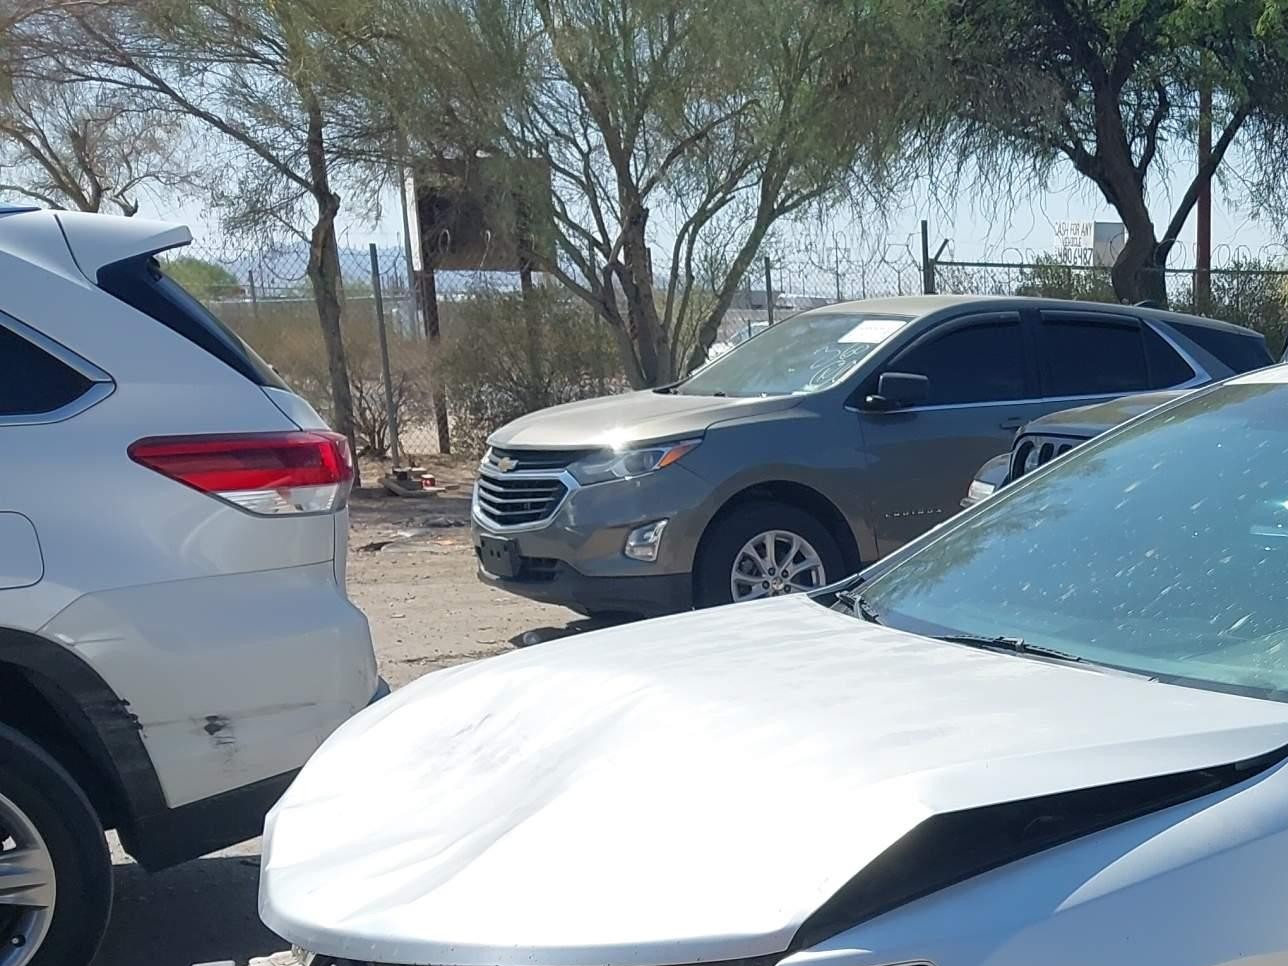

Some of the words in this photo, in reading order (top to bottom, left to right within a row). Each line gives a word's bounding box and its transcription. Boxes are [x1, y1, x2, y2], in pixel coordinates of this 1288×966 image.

[1055, 221, 1069, 236] CASH
[1070, 222, 1080, 236] FOR
[1081, 222, 1093, 236] ANY
